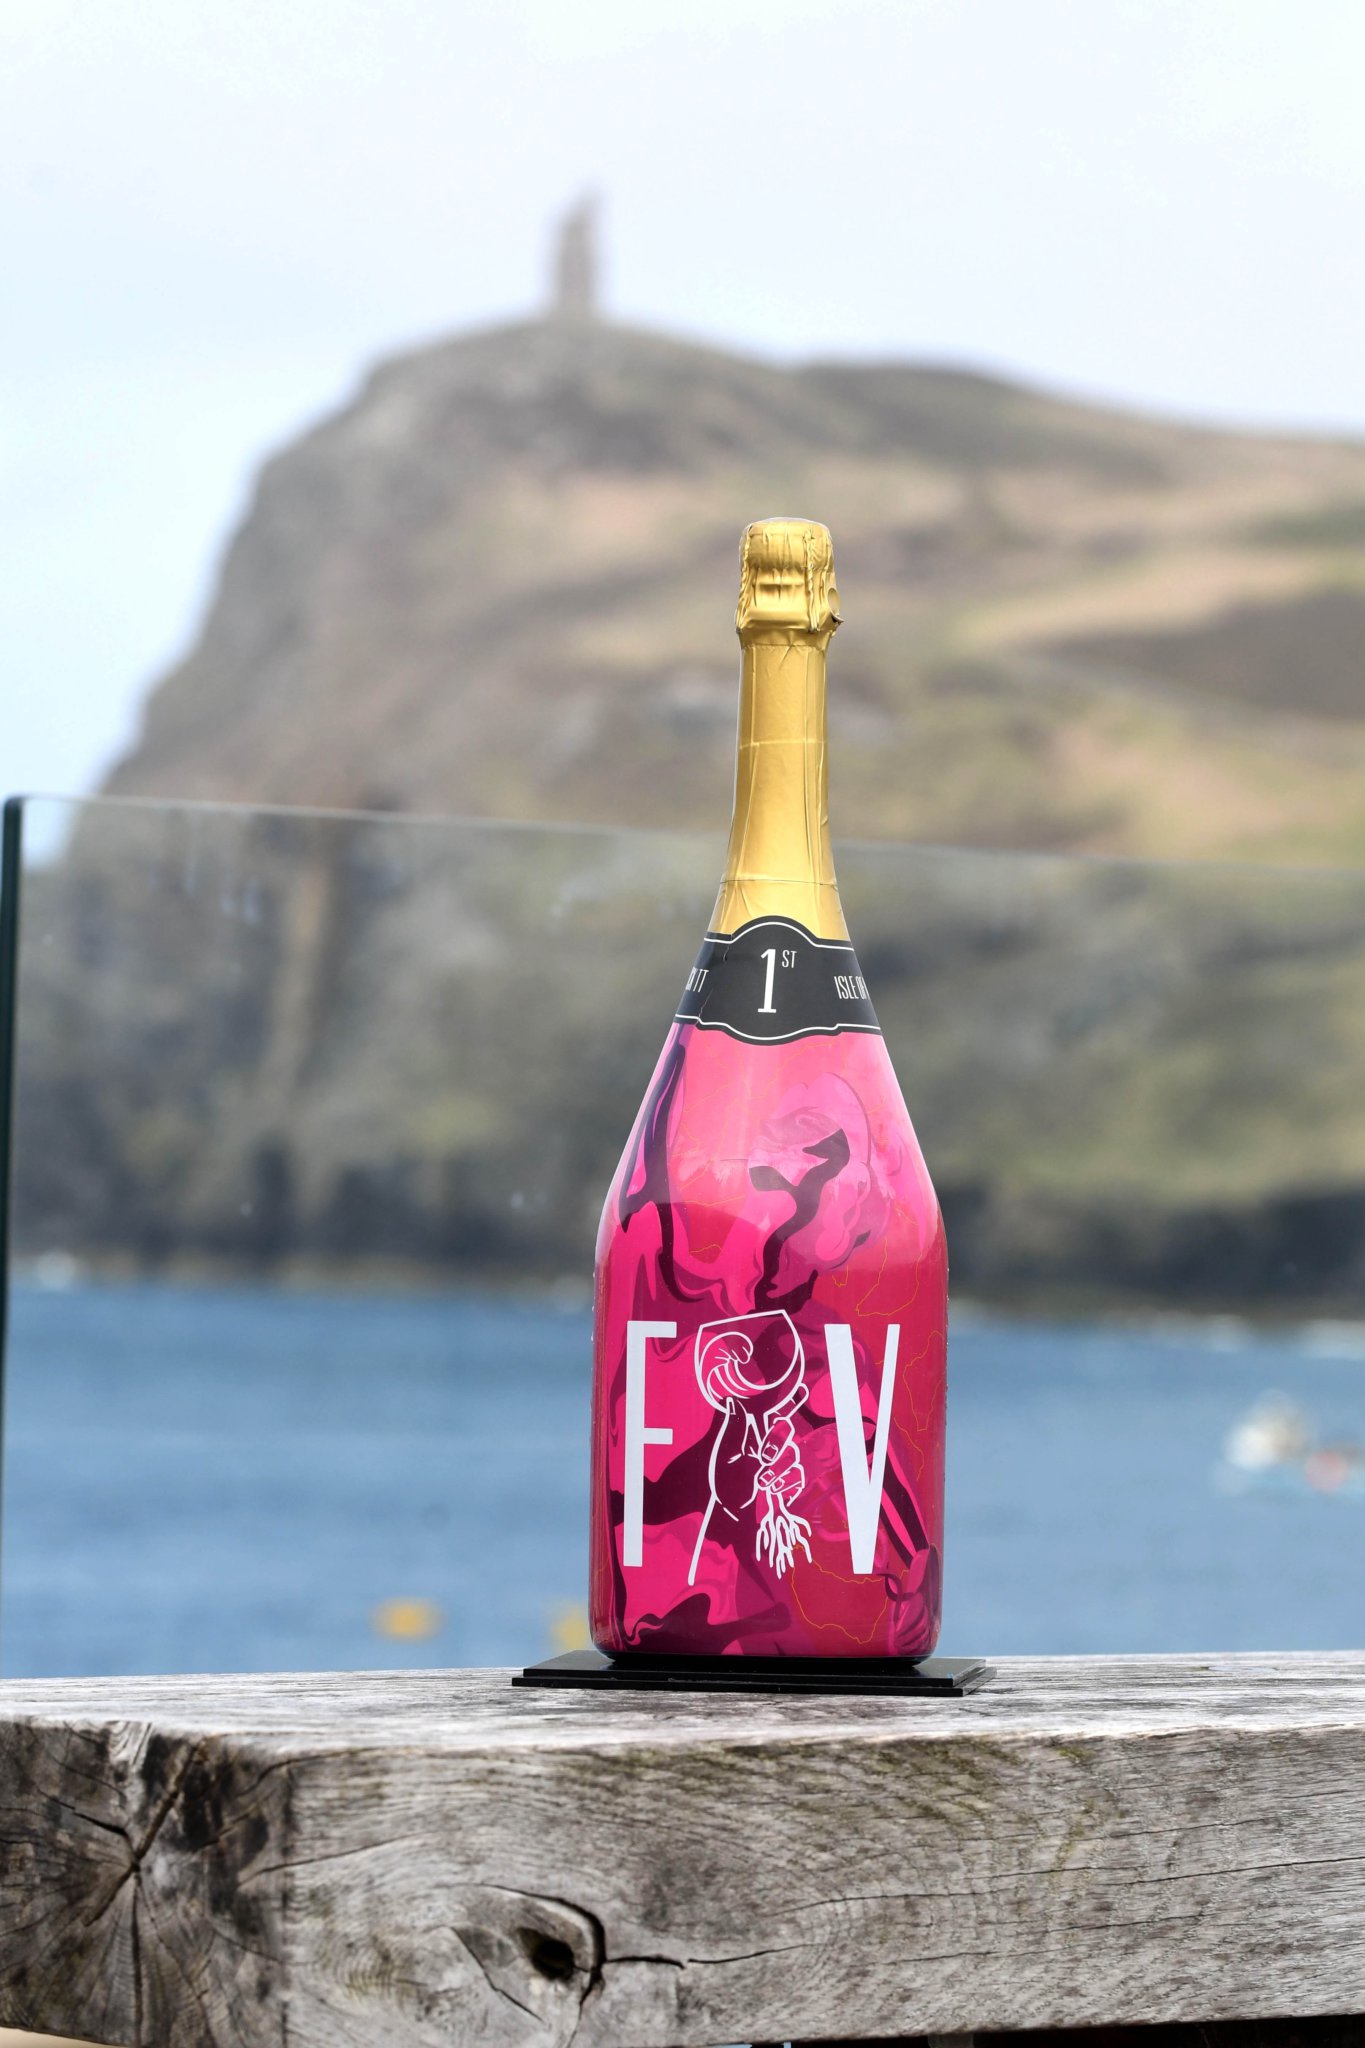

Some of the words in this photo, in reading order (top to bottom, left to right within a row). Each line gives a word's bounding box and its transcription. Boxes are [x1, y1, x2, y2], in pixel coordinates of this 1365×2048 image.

[833, 975, 859, 1000] ISLE
[623, 1320, 677, 1567] F
[824, 1323, 900, 1575] V
